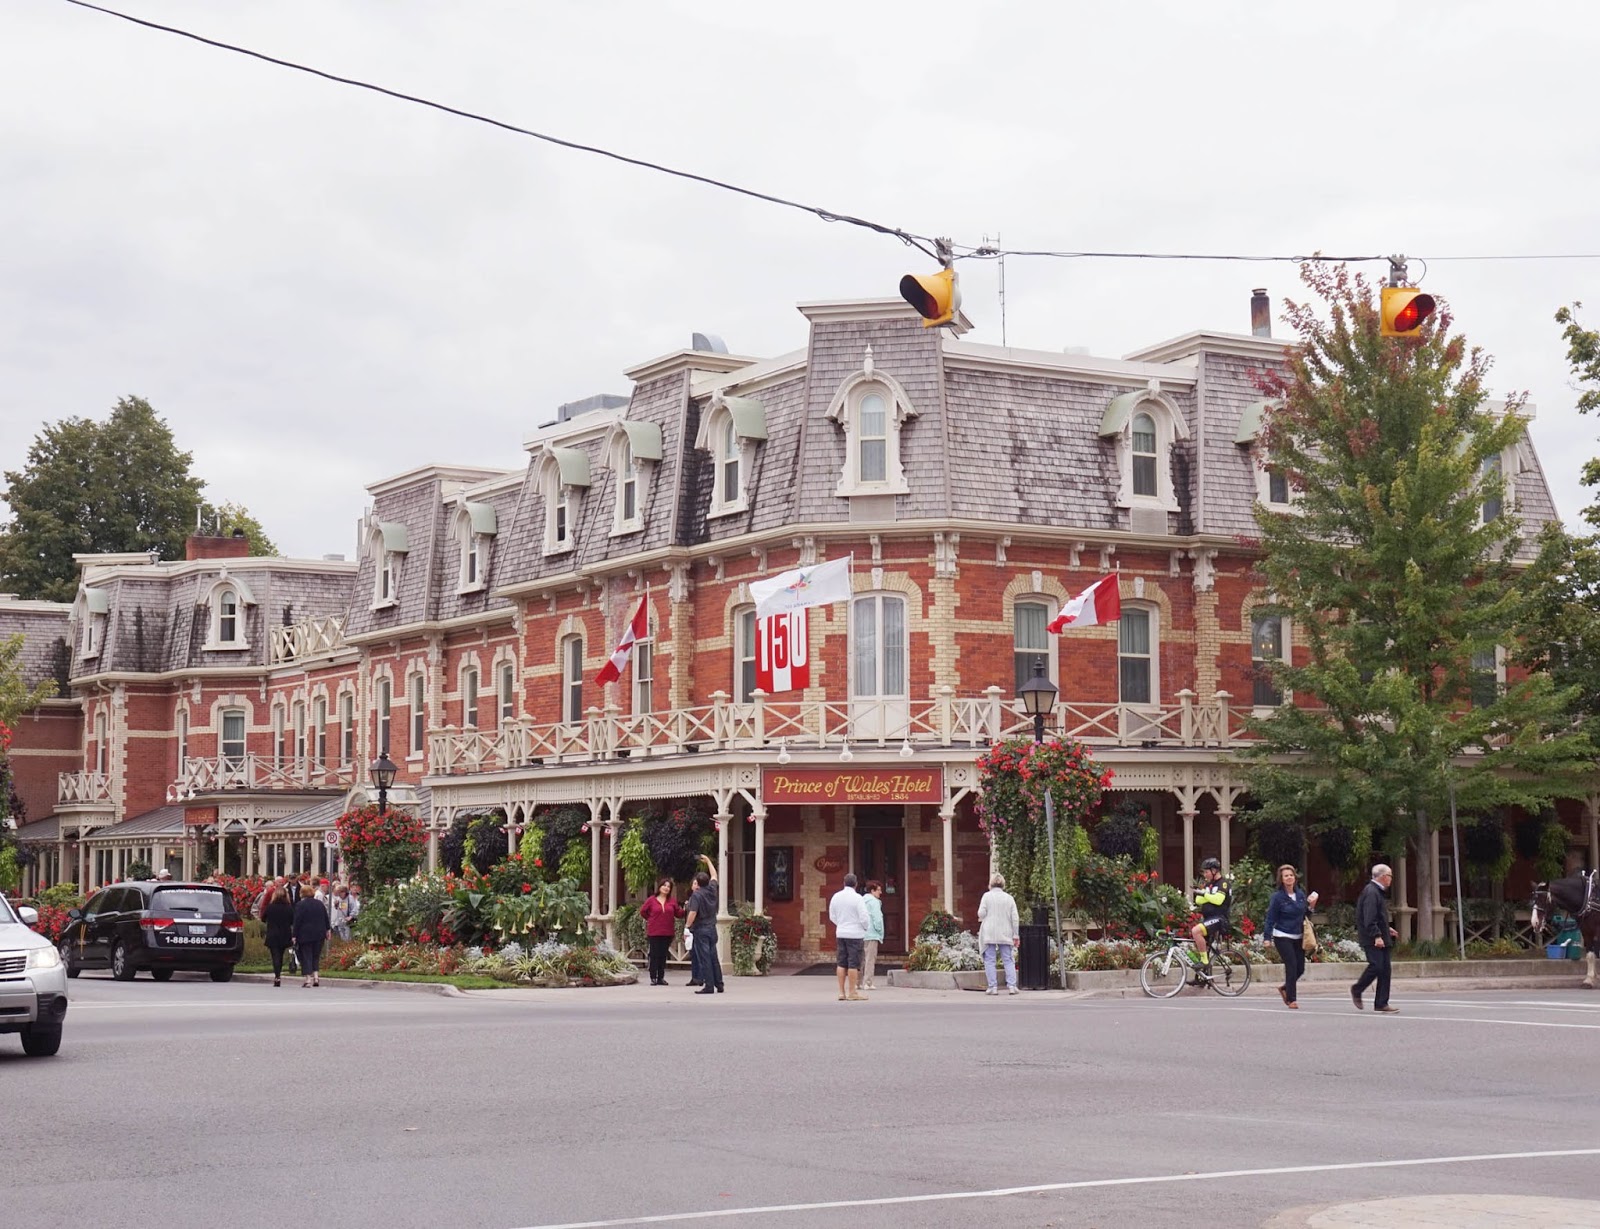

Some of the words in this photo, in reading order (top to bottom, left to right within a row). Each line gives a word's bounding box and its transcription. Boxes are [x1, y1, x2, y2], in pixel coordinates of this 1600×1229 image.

[758, 607, 808, 672] 150
[773, 776, 822, 794] Prince
[824, 774, 842, 798] of
[841, 775, 891, 795] Wales
[890, 775, 933, 793] Hotel
[817, 858, 841, 870] Open
[165, 936, 227, 945] 1-888-669-5566
